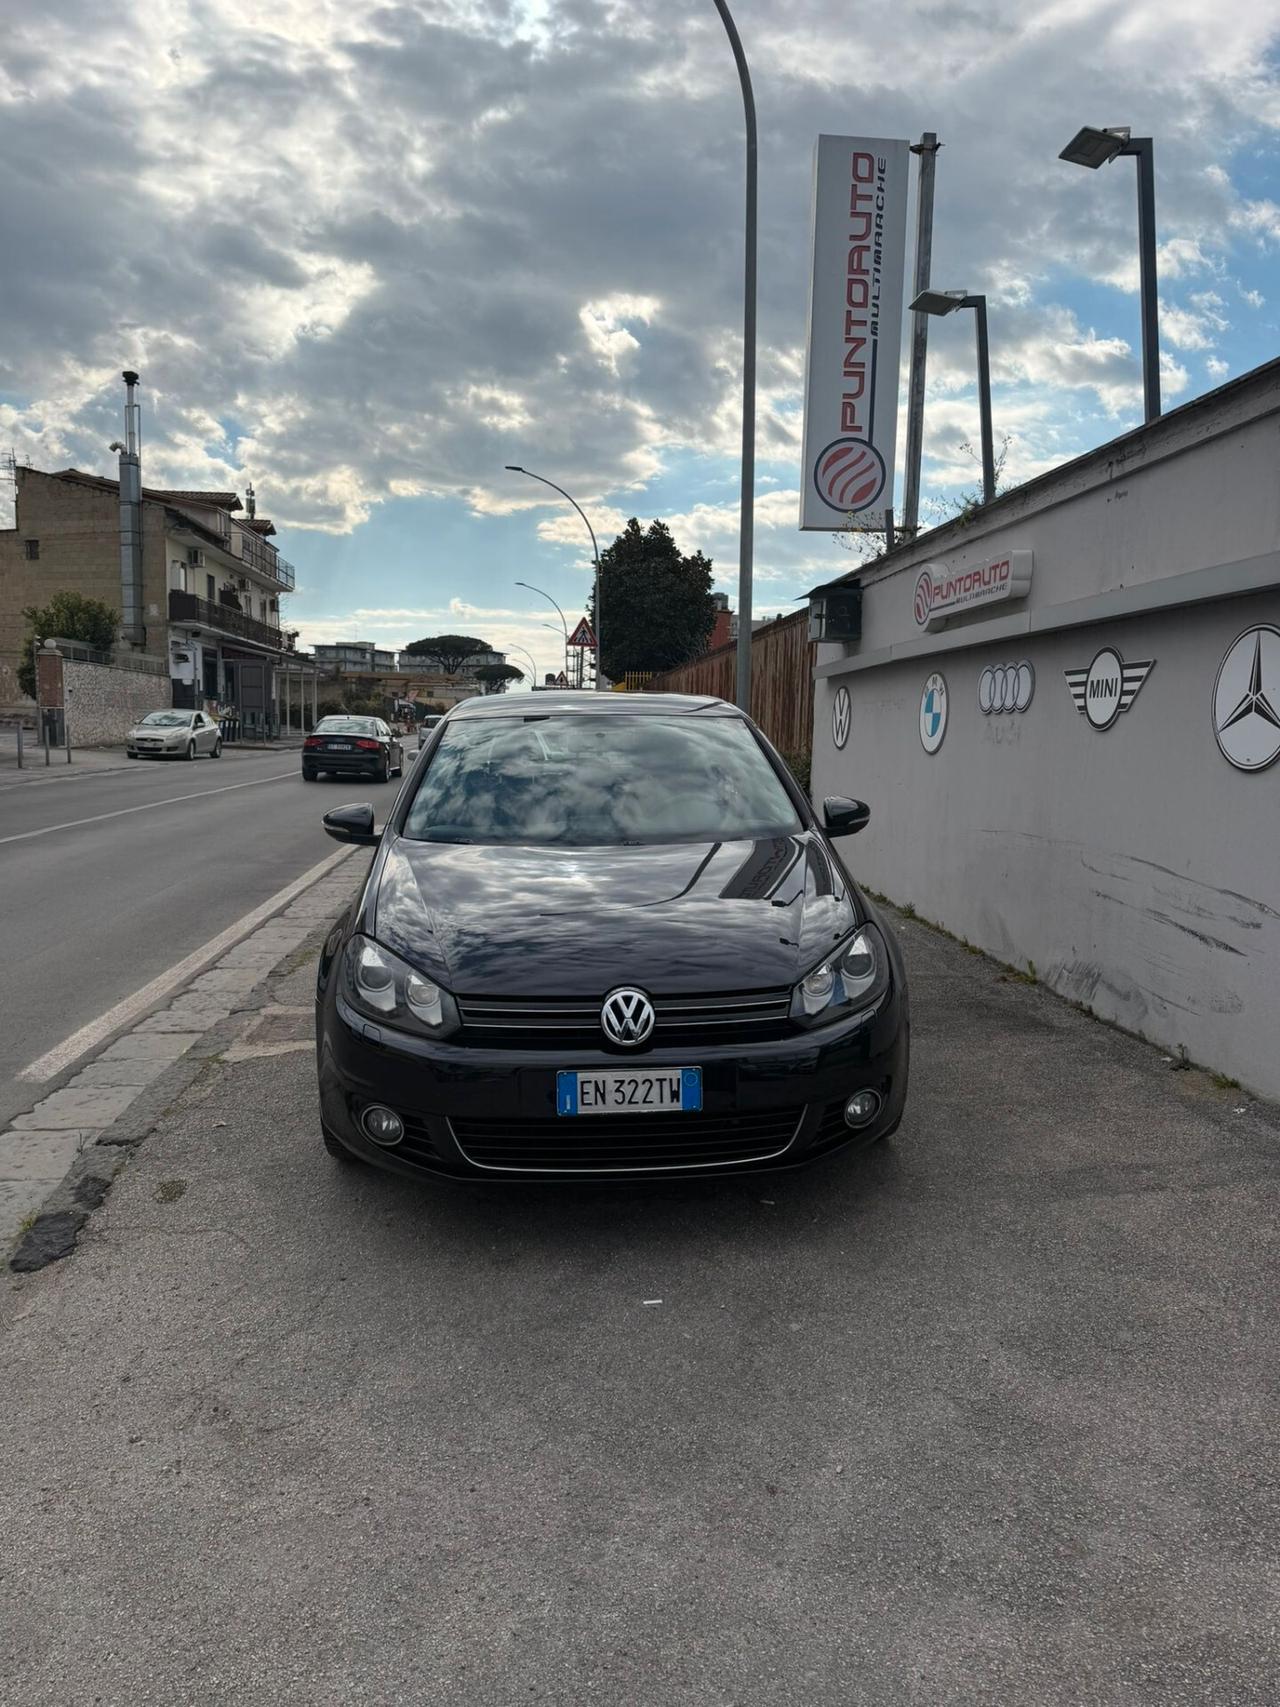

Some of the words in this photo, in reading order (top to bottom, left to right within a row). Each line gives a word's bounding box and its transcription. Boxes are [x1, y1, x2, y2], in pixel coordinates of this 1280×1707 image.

[870, 157, 887, 337] MULTIMARCHE
[841, 152, 875, 432] PUNTOAUTO
[932, 560, 1009, 602] PUNTOAUTO
[1089, 677, 1118, 699] MINI
[579, 1079, 607, 1106] EN
[613, 1077, 681, 1105] 322TW
